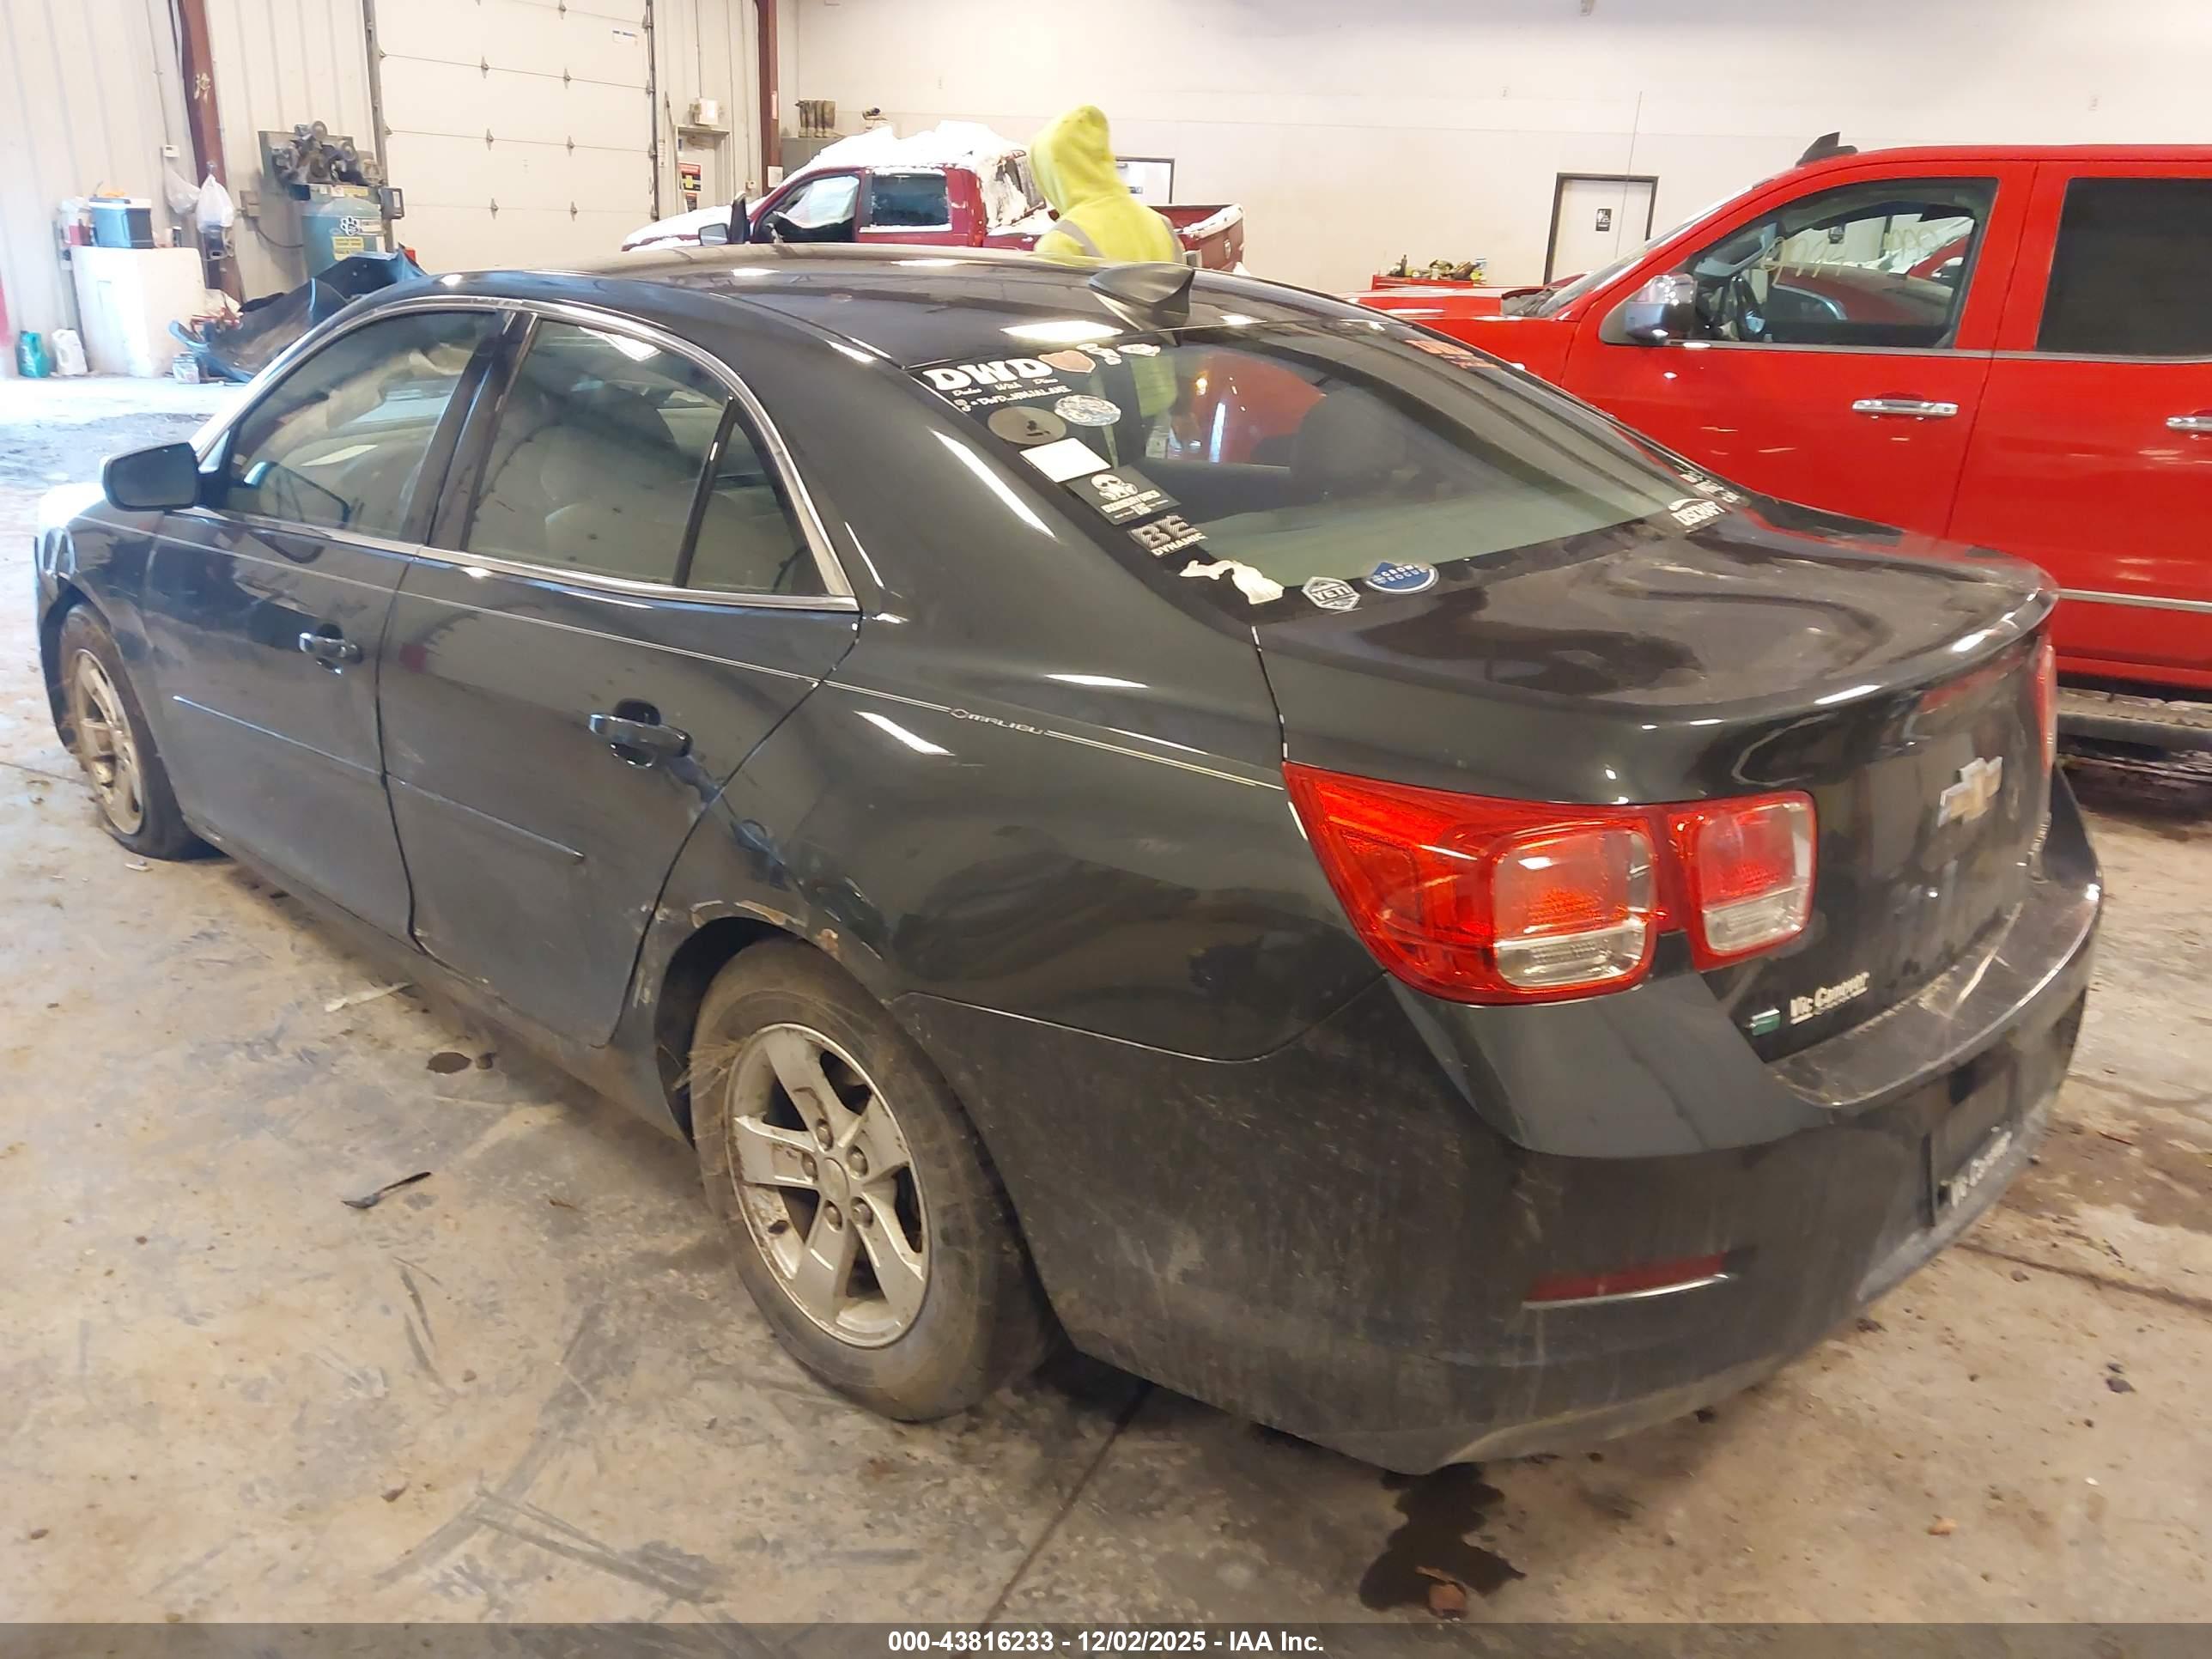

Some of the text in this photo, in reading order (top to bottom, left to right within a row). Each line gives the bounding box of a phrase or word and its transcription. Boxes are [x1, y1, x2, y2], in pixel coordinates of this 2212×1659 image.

[922, 358, 1054, 391] DWD
[1152, 532, 1208, 556] DYNAMIC
[1312, 586, 1352, 601] YETI
[968, 714, 1043, 735] MALIBU
